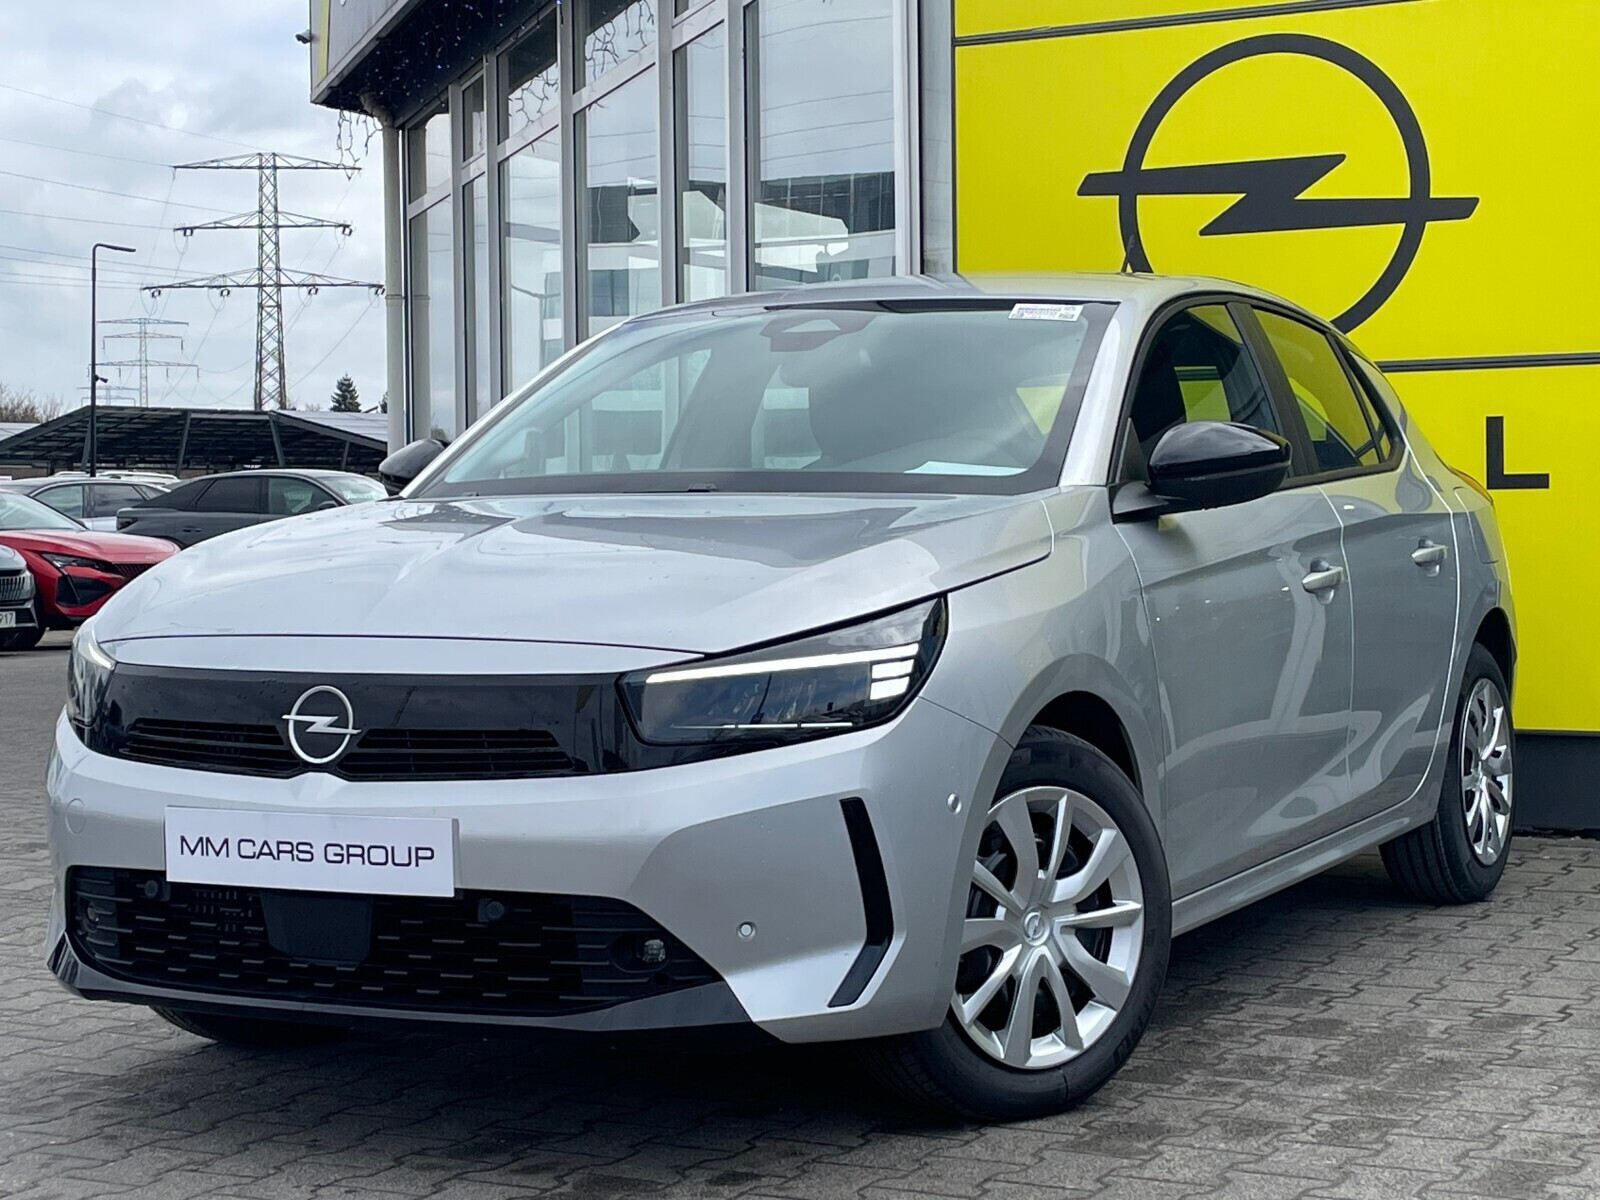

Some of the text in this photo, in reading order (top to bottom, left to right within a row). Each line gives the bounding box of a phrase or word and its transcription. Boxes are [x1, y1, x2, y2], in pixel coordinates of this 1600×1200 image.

[1486, 416, 1549, 489] L
[180, 835, 435, 867] MM CARS GROUP
